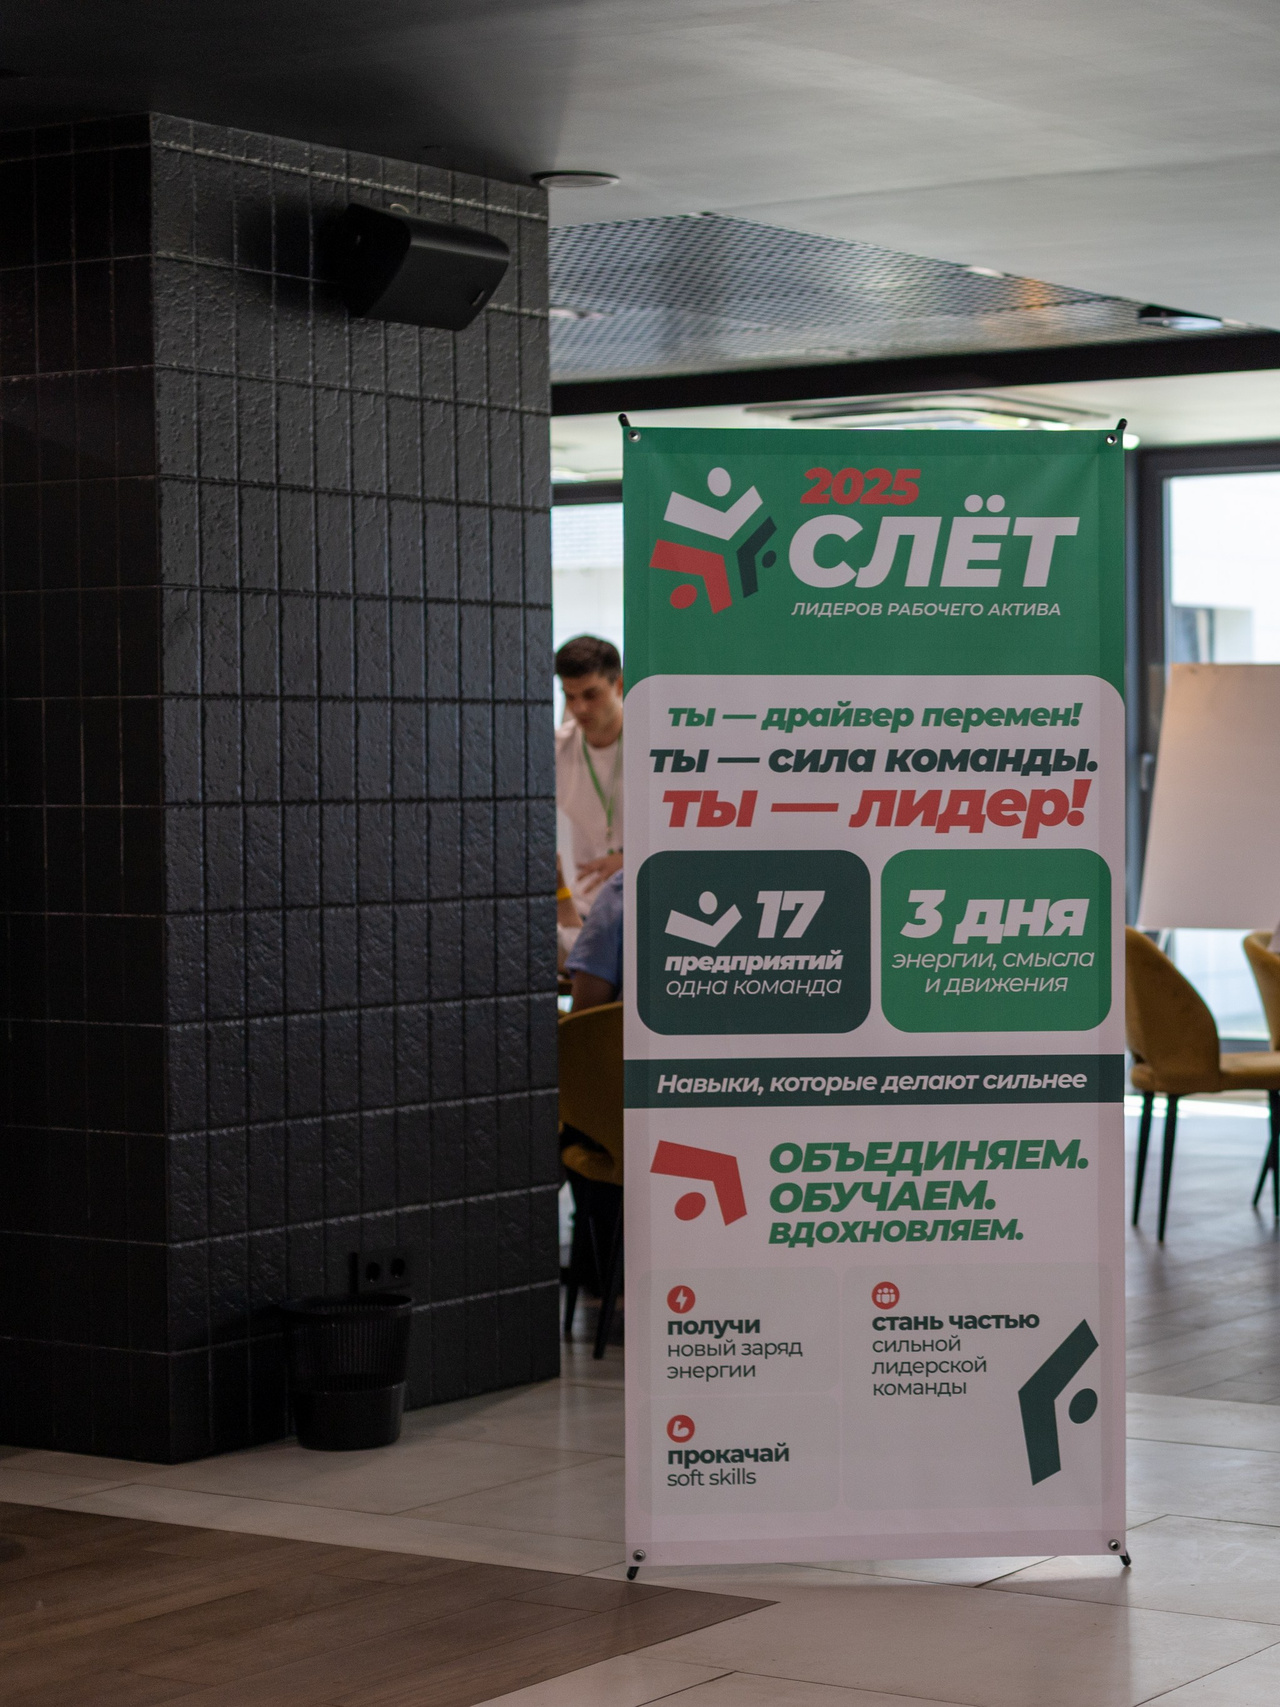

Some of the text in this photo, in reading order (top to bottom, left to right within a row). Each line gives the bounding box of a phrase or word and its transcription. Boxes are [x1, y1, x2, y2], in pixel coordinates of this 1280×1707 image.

[800, 466, 922, 506] 2025
[788, 493, 1080, 590] СЛЁТ
[790, 601, 1062, 618] ЛИДЕРОВ РАБОЧЕГО АКТИВА
[668, 706, 717, 727] ты
[761, 700, 915, 734] драйвер
[921, 702, 1083, 734] перемен!
[649, 748, 709, 773] ты
[768, 748, 877, 773] сила
[884, 748, 1098, 776] команды.
[662, 790, 758, 829] ты
[849, 779, 1092, 839] лидер!
[756, 890, 826, 939] 17
[899, 888, 1090, 945] 3 дня
[664, 949, 844, 977] предприятий
[891, 950, 1095, 971] энергии, смысла
[665, 977, 842, 998] одна команда
[924, 976, 1068, 996] и движения
[656, 1071, 1087, 1096] Навыки, которые делают сильнее
[768, 1139, 1090, 1177] ОБЪЕДИНЯЕМ.
[768, 1180, 996, 1214] ОБУЧАЕМ.
[768, 1218, 1024, 1248] ВДОХНОВЛЯЕМ.
[667, 1317, 761, 1340] получи
[872, 1311, 1040, 1332] стань частью
[667, 1340, 803, 1360] новый заряд
[872, 1335, 961, 1353] сильной
[667, 1362, 756, 1384] энергии
[872, 1356, 987, 1378] лидерской
[872, 1379, 968, 1398] команды
[667, 1444, 790, 1469] прокачай
[667, 1468, 756, 1488] soft skills
